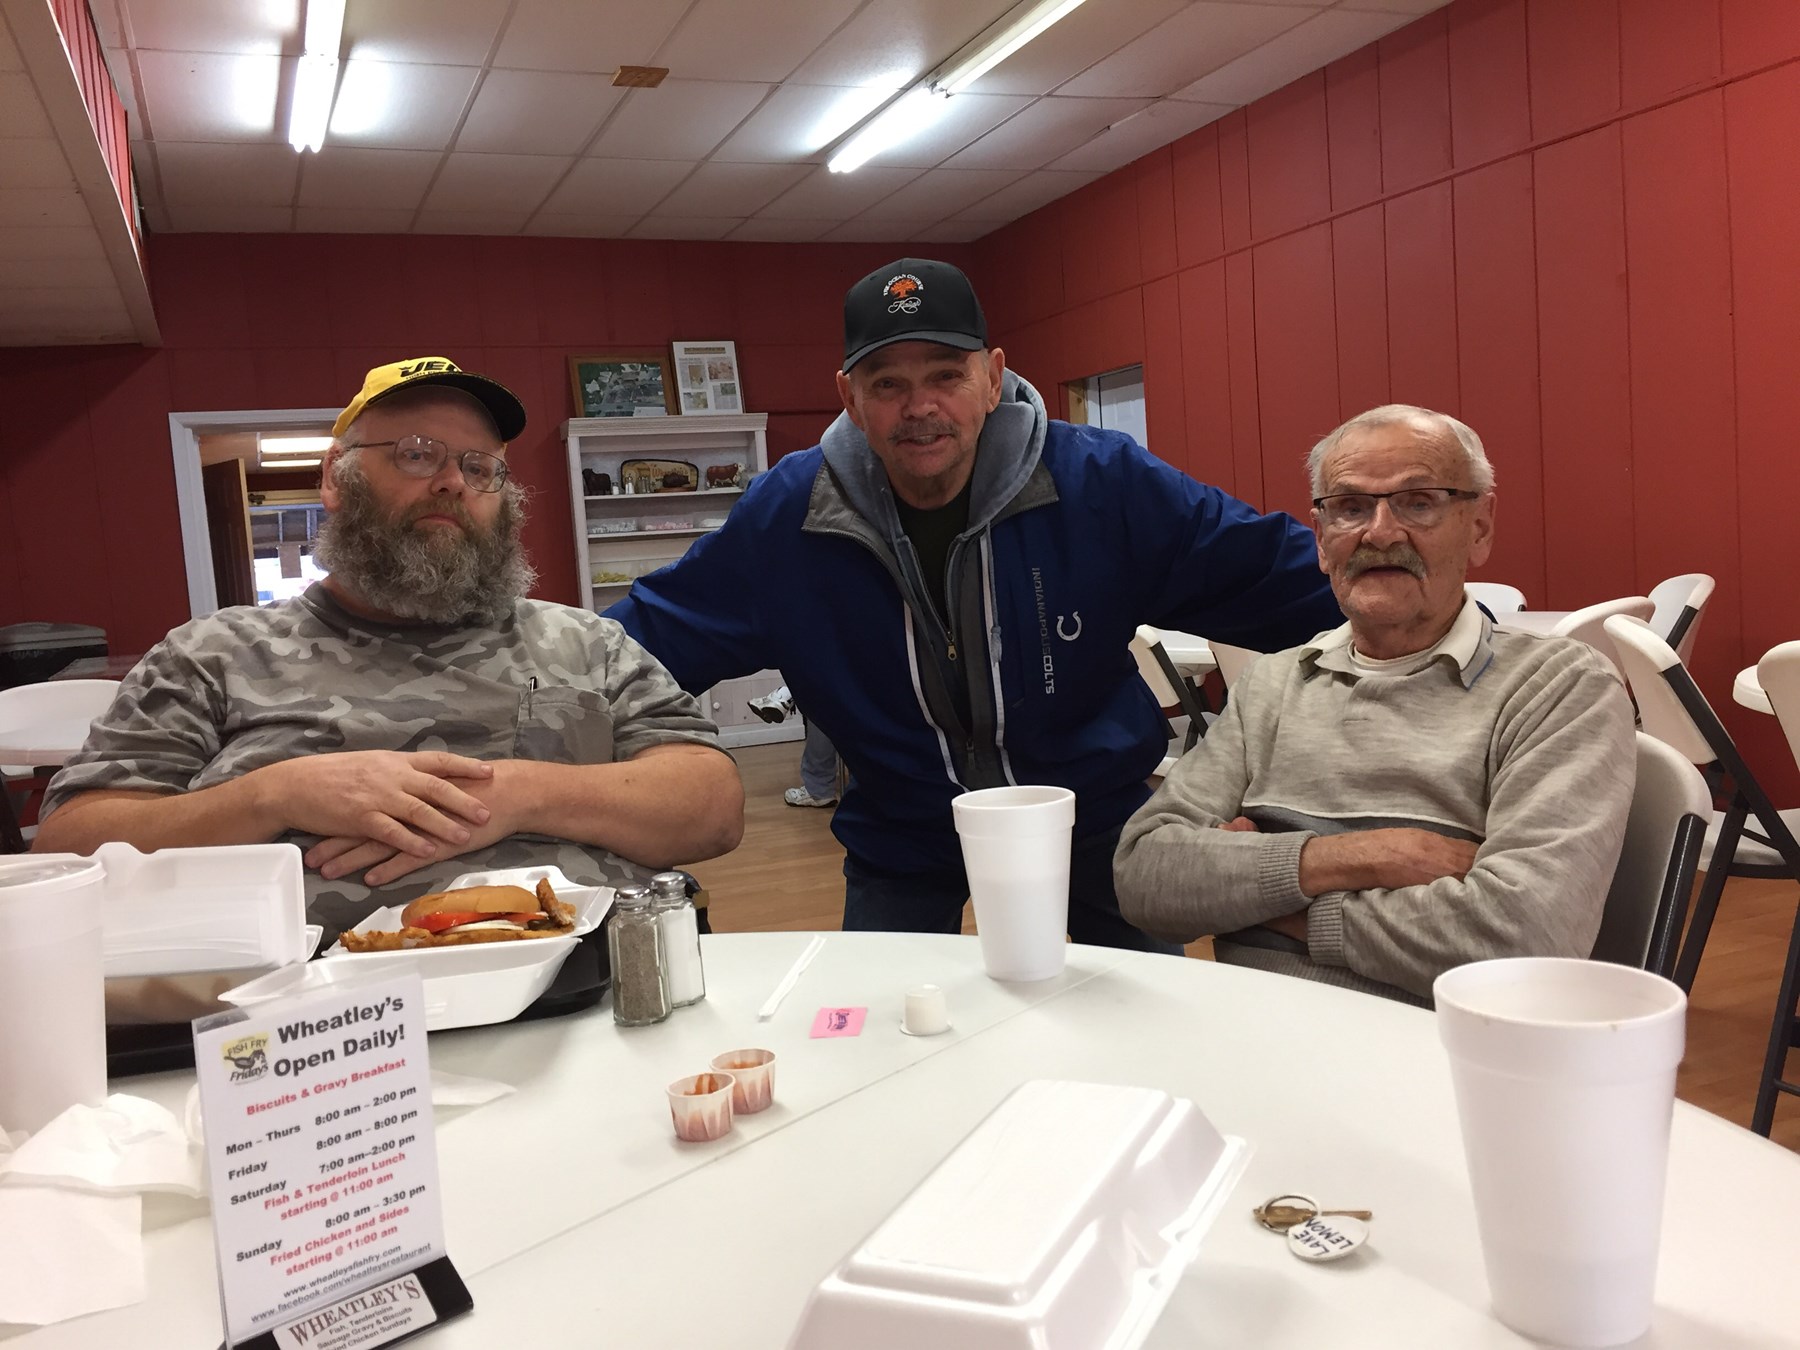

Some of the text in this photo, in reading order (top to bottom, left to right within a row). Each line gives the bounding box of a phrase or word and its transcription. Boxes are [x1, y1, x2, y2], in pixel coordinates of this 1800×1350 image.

[1032, 567, 1055, 694] INDIANAPOLIS COLTS
[228, 1042, 248, 1057] FISH
[251, 1039, 267, 1047] FRY
[277, 997, 403, 1044] Wheatley's
[274, 1024, 405, 1076] Open Daily!
[247, 1058, 405, 1116] Biscuits & Gravy Breakfast
[226, 1139, 253, 1155] Mon
[266, 1124, 301, 1142] Thurs
[315, 1110, 340, 1125] 8:00
[343, 1103, 361, 1116] am
[373, 1091, 397, 1107] 2:00
[400, 1086, 417, 1102] pm
[229, 1160, 267, 1180] Friday
[316, 1134, 341, 1150] 8:00
[345, 1128, 362, 1140] am
[375, 1115, 397, 1130] 8:00
[401, 1109, 418, 1125] pm
[231, 1179, 287, 1205] Saturday
[319, 1158, 344, 1174] 7:00
[398, 1134, 415, 1148] pm
[264, 1152, 405, 1210] Fish & Tenderloin Lunch
[281, 1172, 393, 1221] starting @ 11:00 am
[237, 1239, 282, 1262] Sunday
[326, 1212, 349, 1228] 8:00
[353, 1205, 370, 1217] am
[383, 1190, 405, 1207] 3:30
[409, 1185, 425, 1200] pm
[270, 1205, 409, 1266] Fried Chicken and Sides
[286, 1225, 397, 1276] starting @ 11:00 am
[1293, 1229, 1330, 1256] LAKE
[1305, 1218, 1354, 1250] LEMON
[289, 1279, 420, 1346] WHEATLEY'S
[352, 1323, 374, 1337] Gravy
[383, 1306, 412, 1322] Biscuits
[380, 1317, 411, 1333] Sundays
